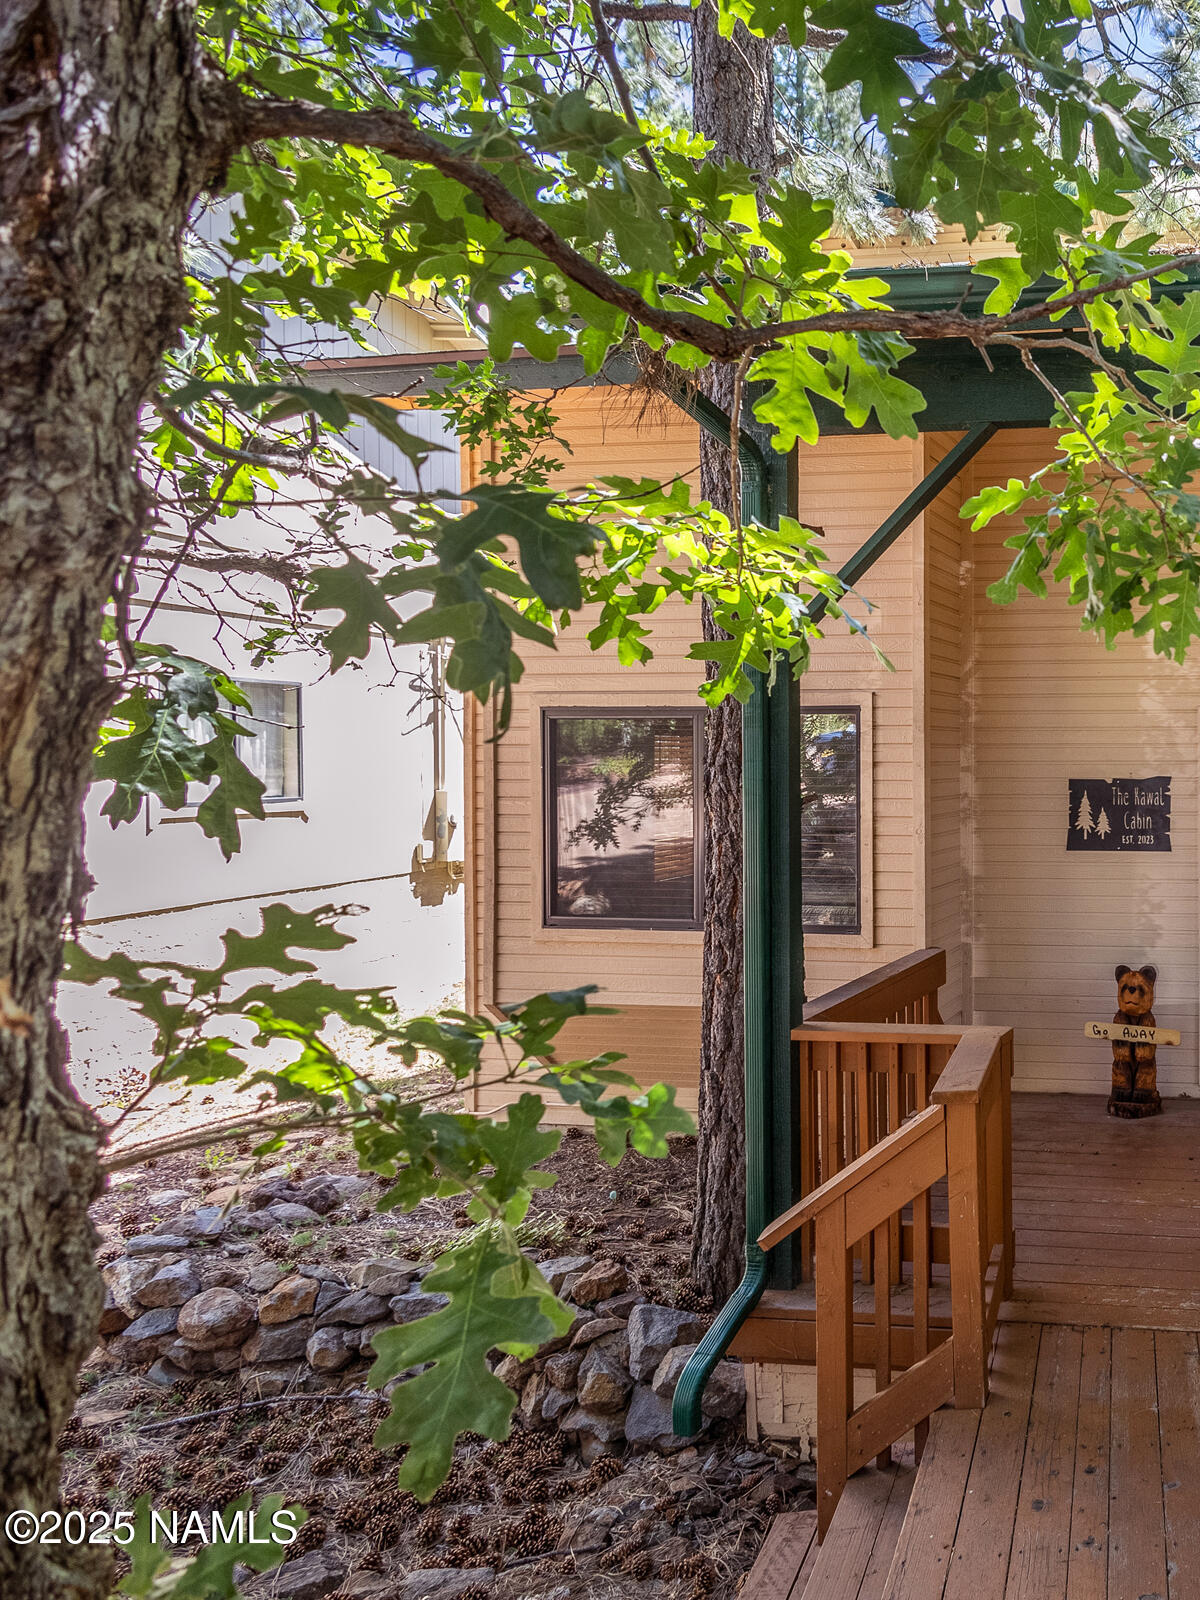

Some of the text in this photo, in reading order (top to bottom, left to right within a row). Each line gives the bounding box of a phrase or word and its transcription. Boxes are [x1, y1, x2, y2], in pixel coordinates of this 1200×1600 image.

[1112, 787, 1165, 806] The Kawal
[1123, 811, 1153, 830] Cabin
[1122, 835, 1155, 845] EST. 2023
[1092, 1024, 1156, 1040] Go AWAY
